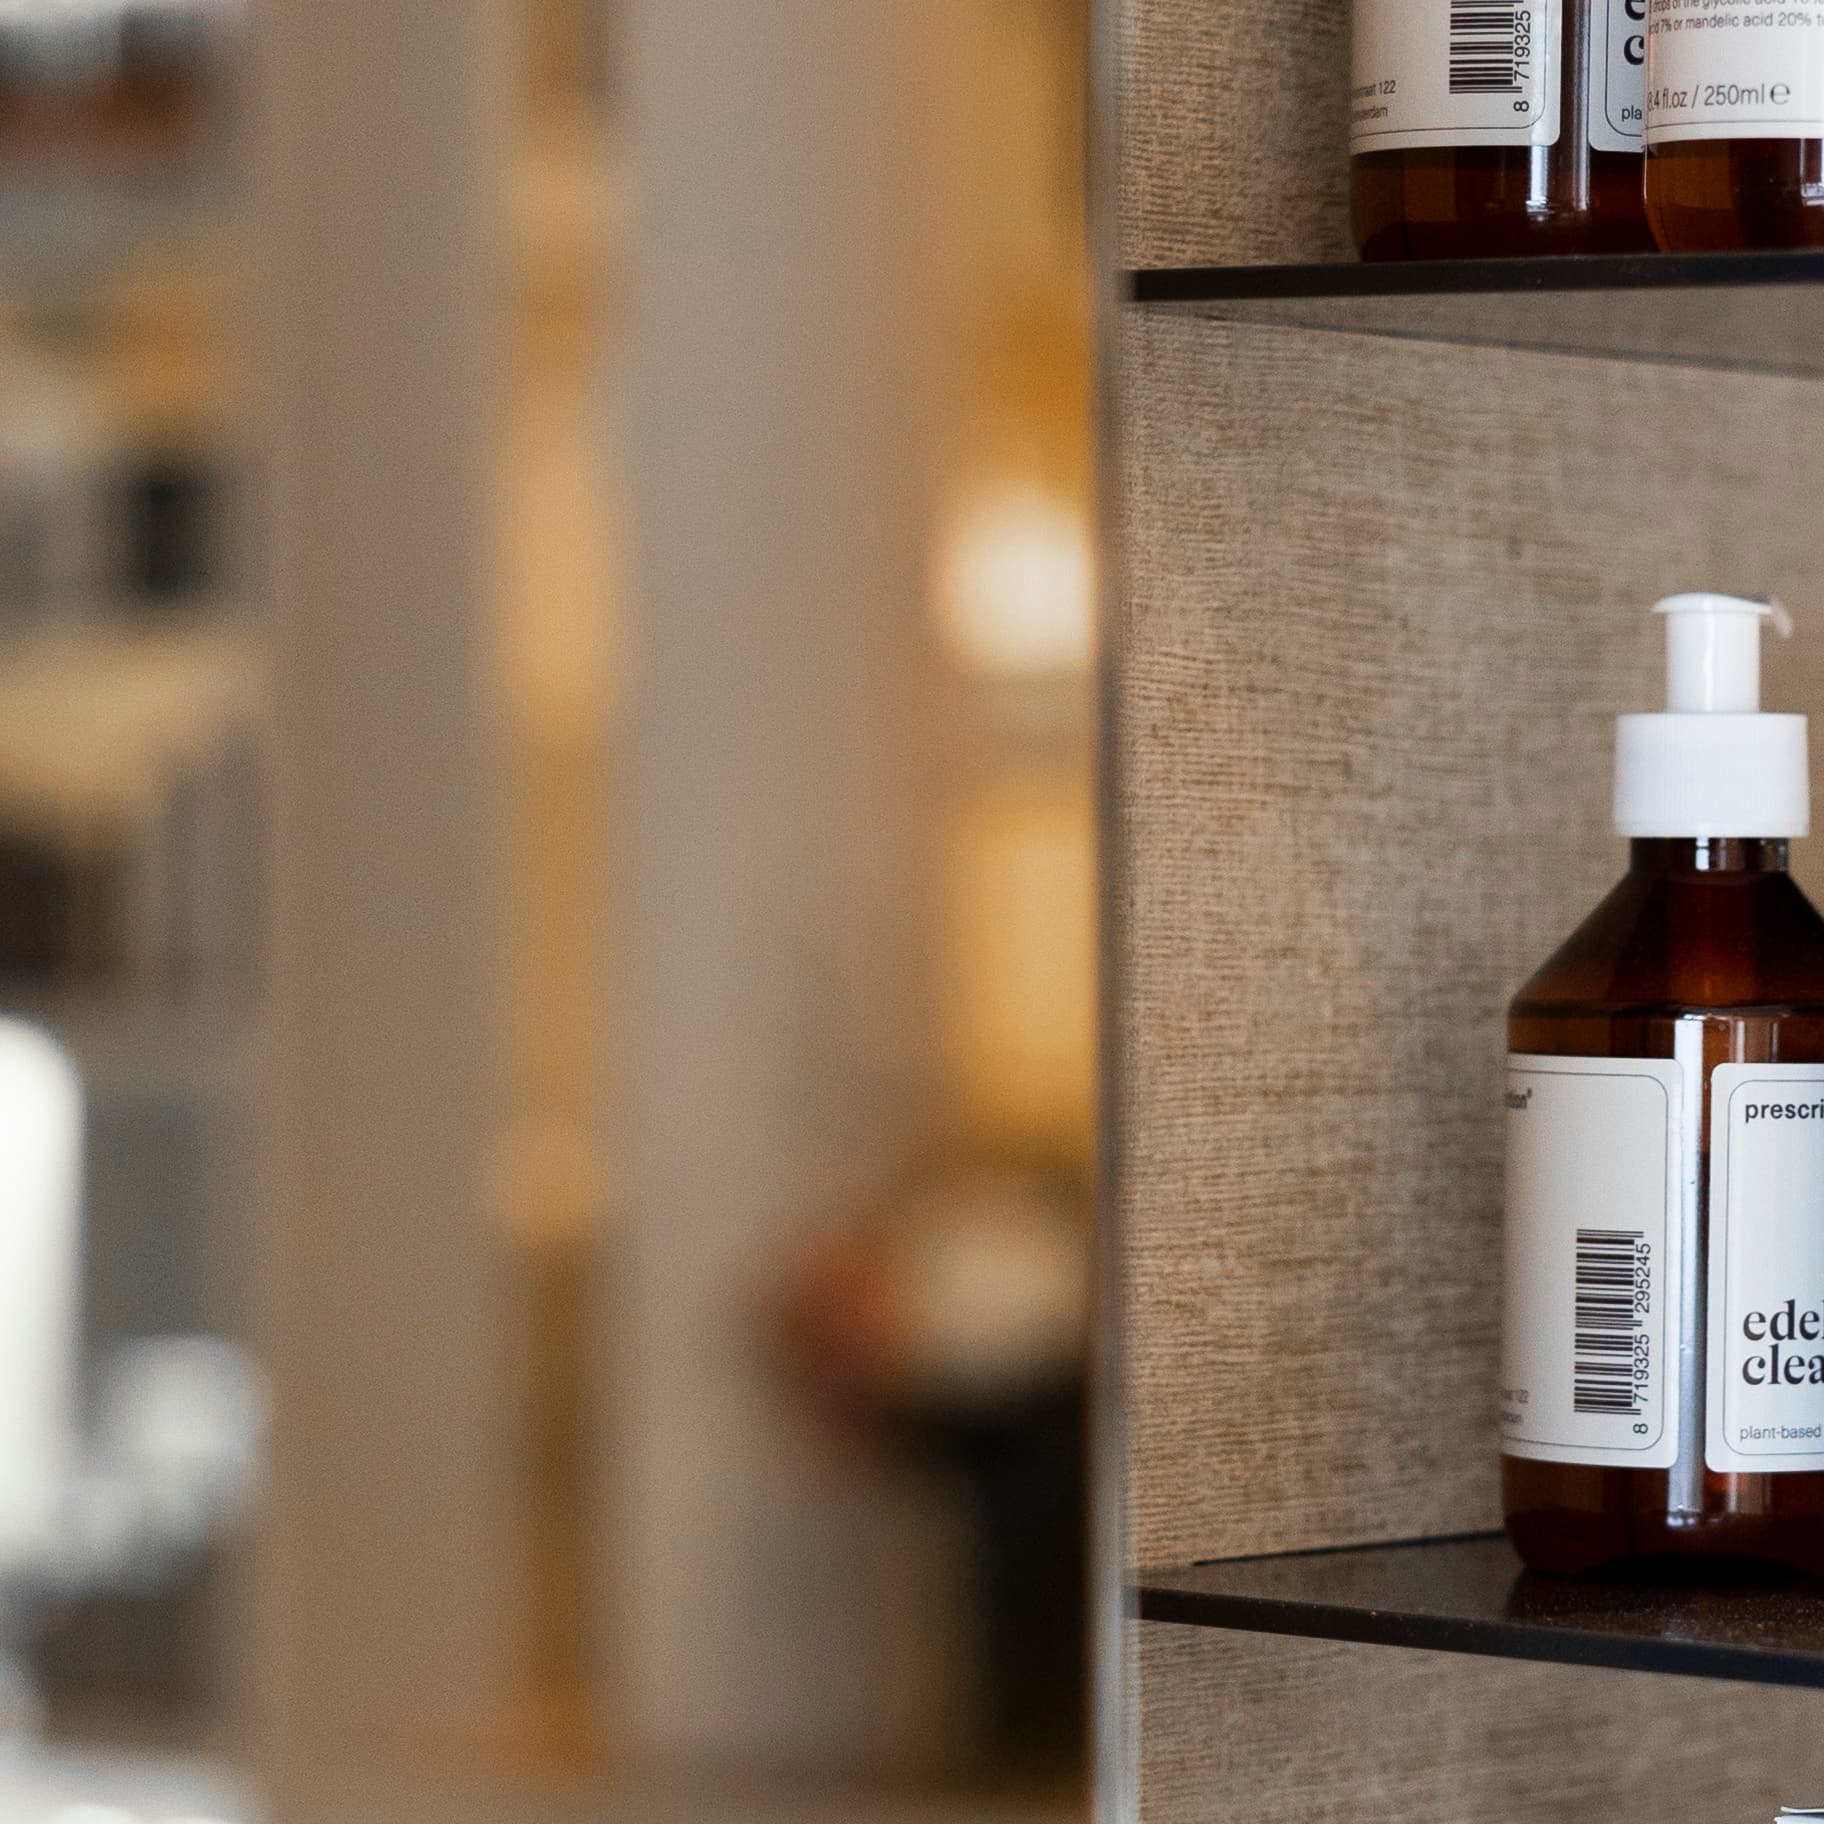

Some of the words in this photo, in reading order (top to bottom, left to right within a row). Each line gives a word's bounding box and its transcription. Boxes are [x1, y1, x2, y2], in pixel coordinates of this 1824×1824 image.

[1514, 10, 1531, 82] 719325
[1514, 100, 1530, 112] 8
[1704, 83, 1765, 107] 250ml
[1634, 1242, 1651, 1313] 295245
[1633, 1334, 1650, 1404] 719325
[1633, 1422, 1649, 1435] 8
